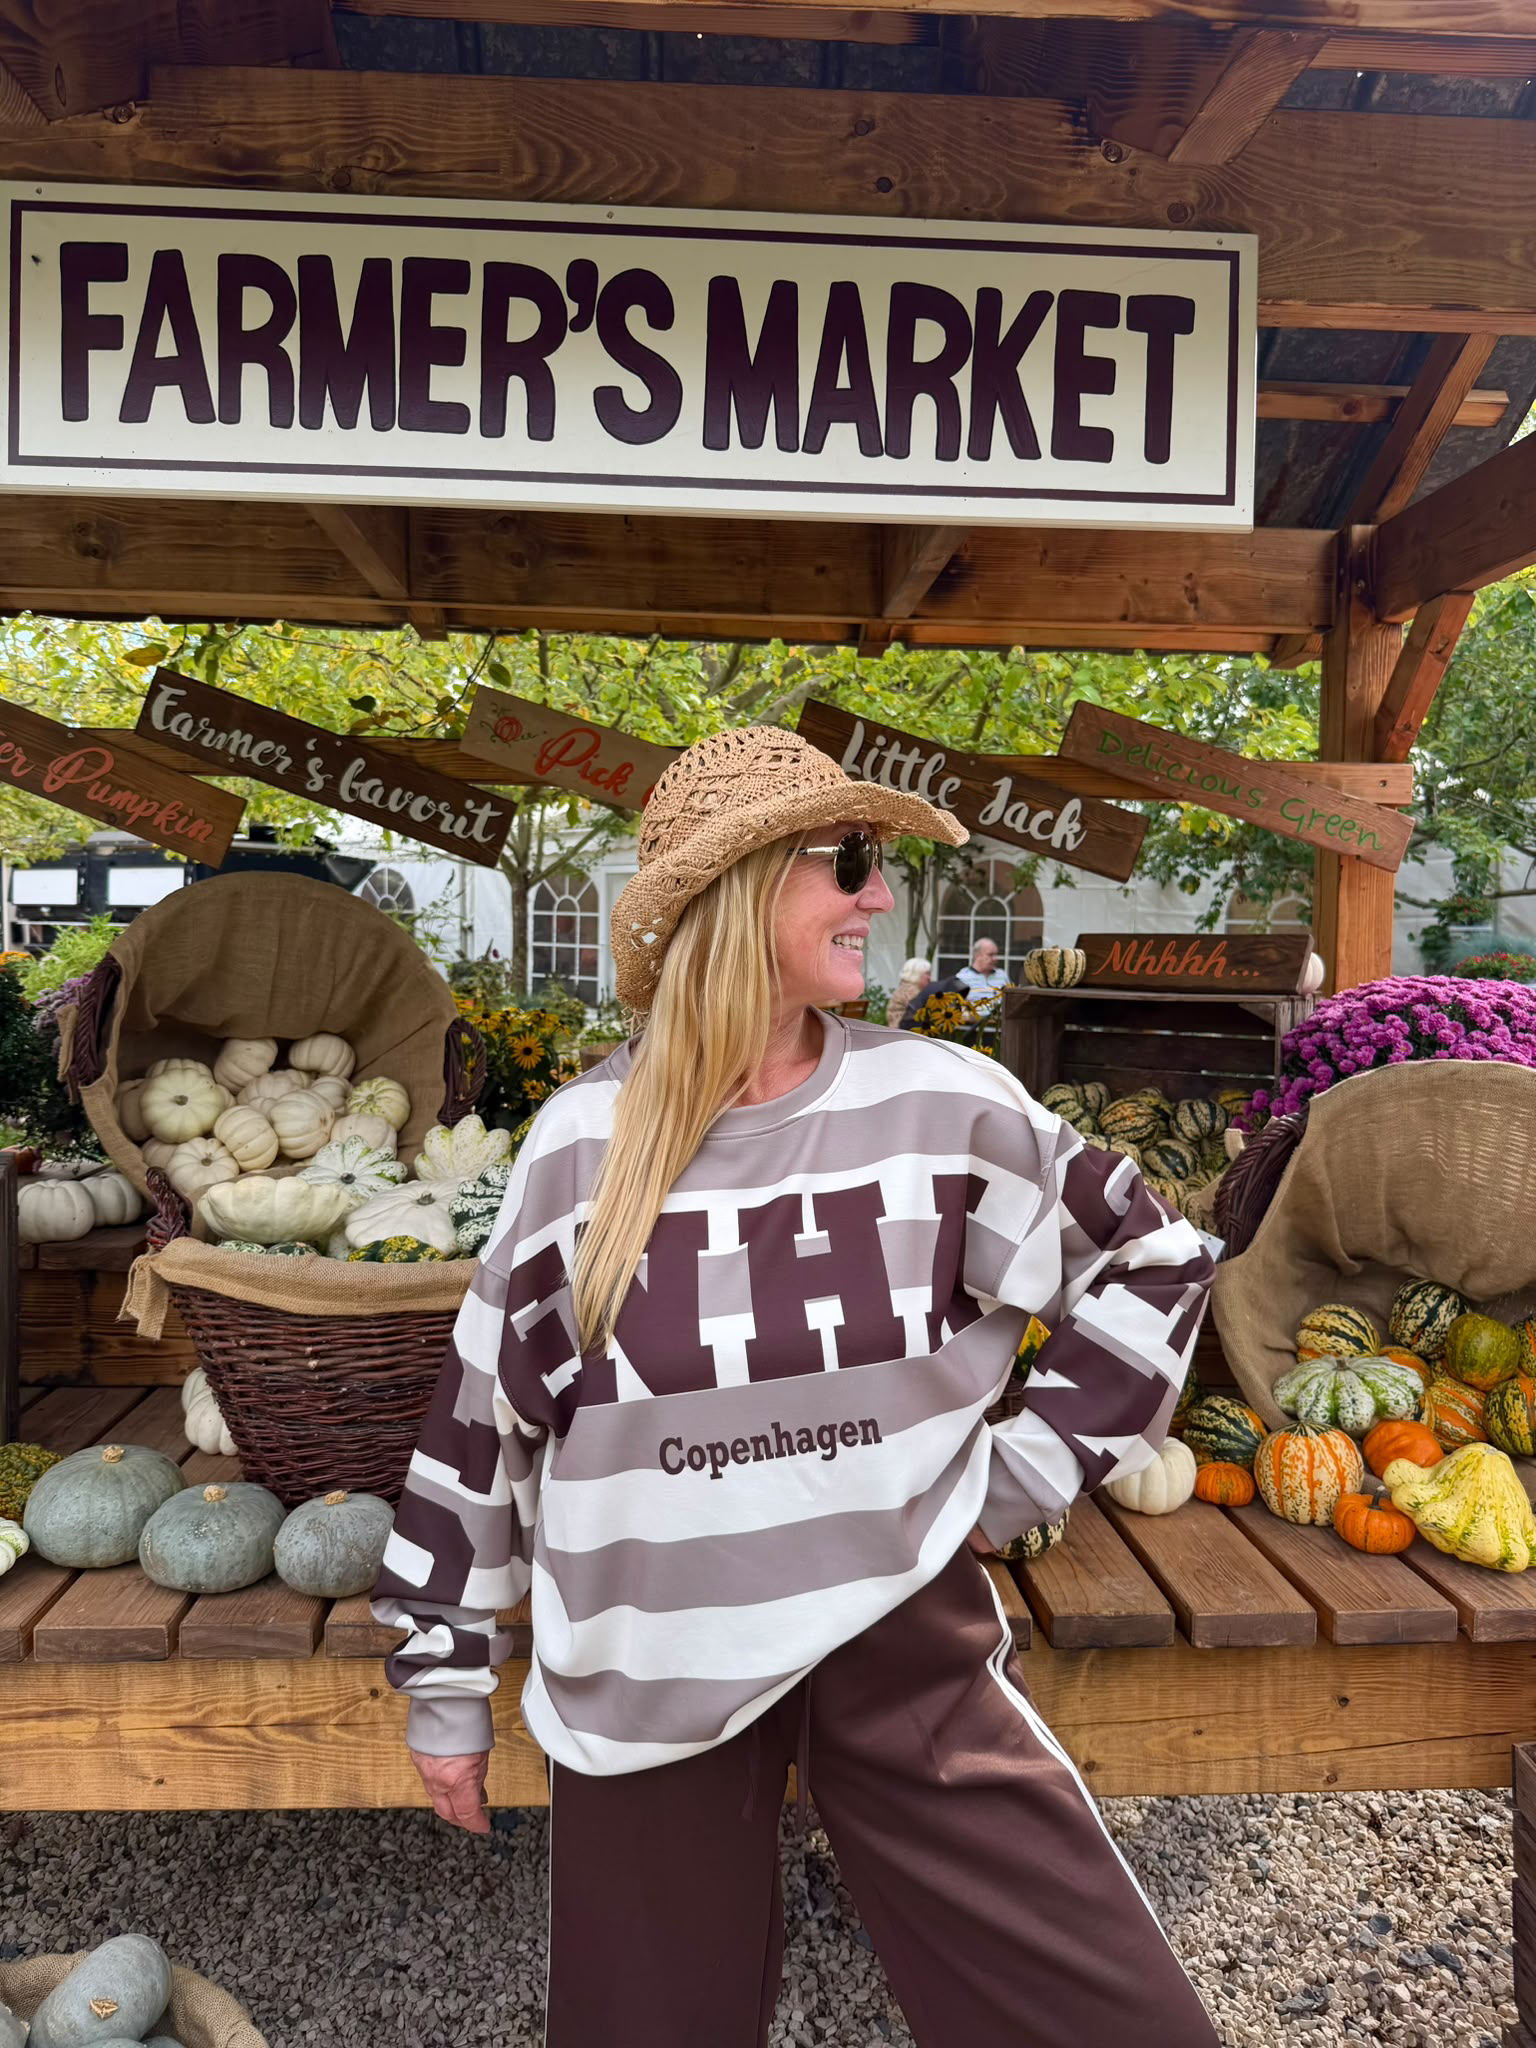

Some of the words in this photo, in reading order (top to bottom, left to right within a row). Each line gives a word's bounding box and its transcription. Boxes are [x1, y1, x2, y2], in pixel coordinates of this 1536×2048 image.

[59, 241, 684, 446] FARMER'S
[702, 274, 1196, 465] MARKET
[0, 741, 36, 777] er
[42, 746, 215, 842] Pumpkin
[150, 683, 333, 792] Farmer's
[534, 727, 635, 797] Pick
[841, 720, 962, 810] Little
[977, 775, 1087, 851] Jack
[1099, 730, 1264, 809] Delicious
[1280, 797, 1386, 851] Green
[658, 1416, 883, 1480] Copenhagen
